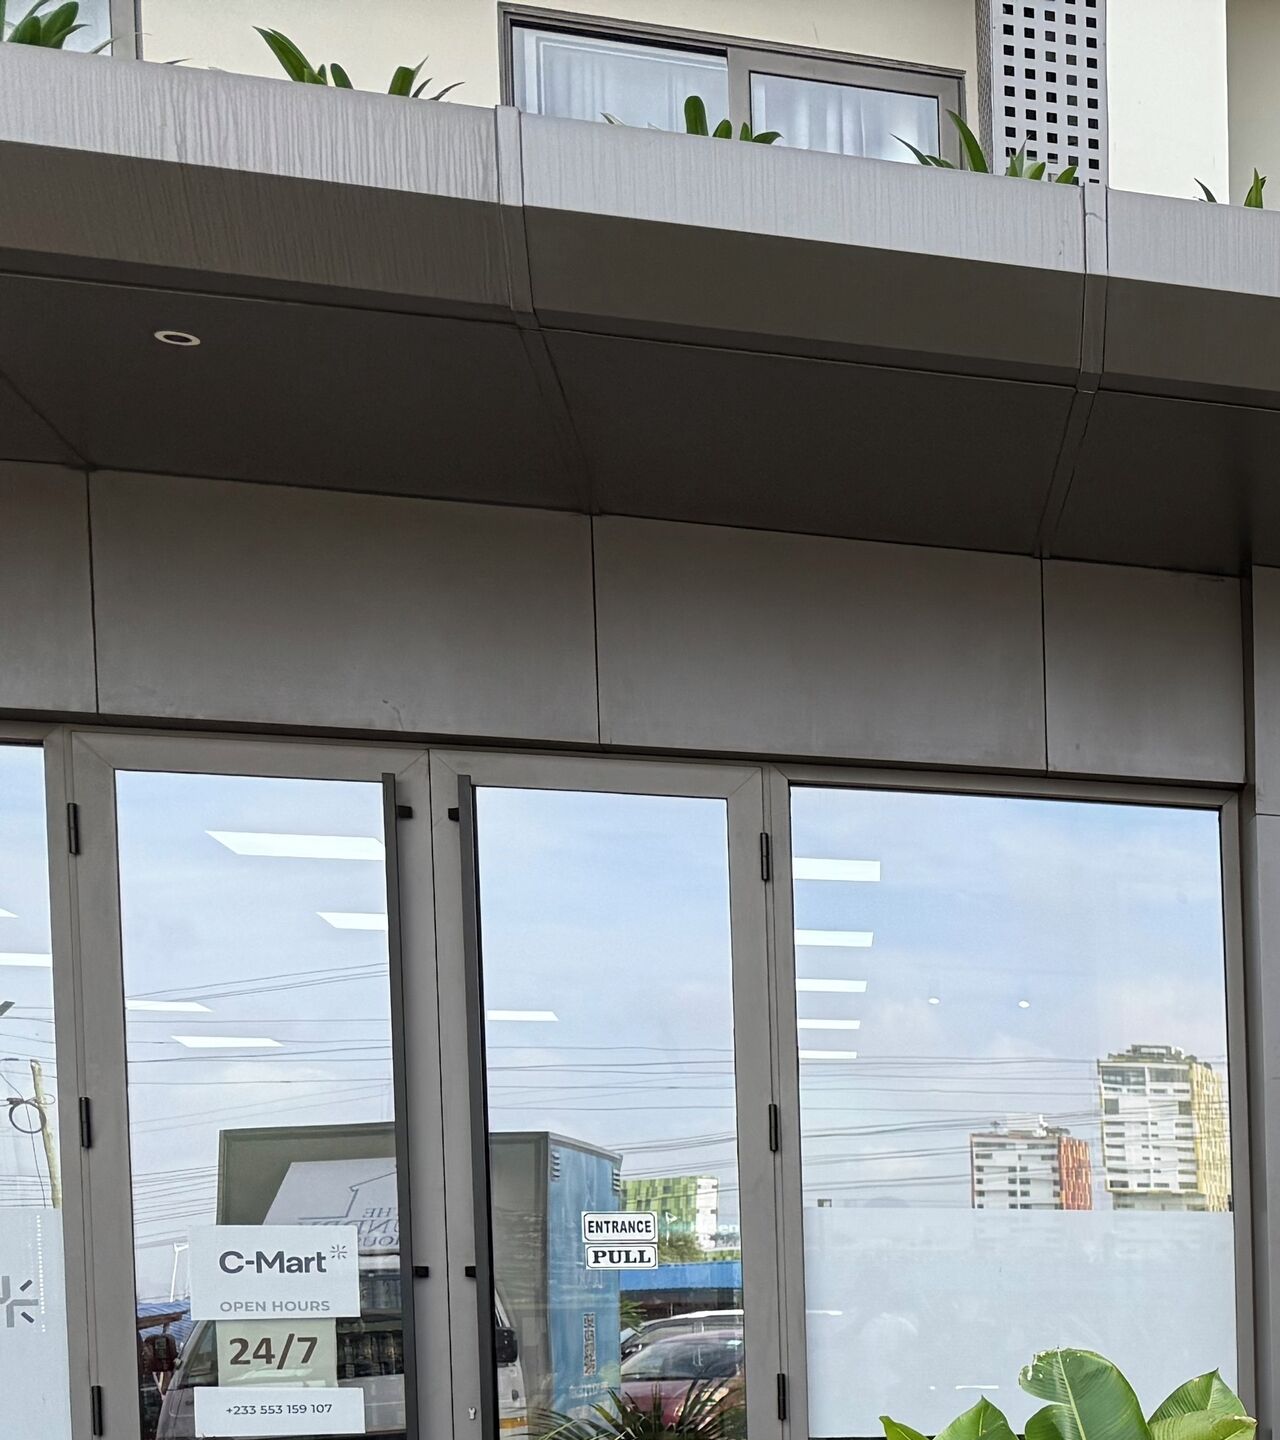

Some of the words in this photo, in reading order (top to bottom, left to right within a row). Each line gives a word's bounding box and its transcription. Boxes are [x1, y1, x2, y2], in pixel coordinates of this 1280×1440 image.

[587, 1220, 652, 1234] ENTRANCE
[218, 1250, 327, 1274] C-Mart
[592, 1250, 651, 1264] PULL
[219, 1301, 267, 1313] OPEN
[272, 1300, 330, 1312] HOURS
[229, 1333, 318, 1370] 24/7
[226, 1405, 257, 1415] +233
[260, 1405, 283, 1415] 553
[287, 1404, 307, 1414] 159
[310, 1403, 332, 1414] 107
